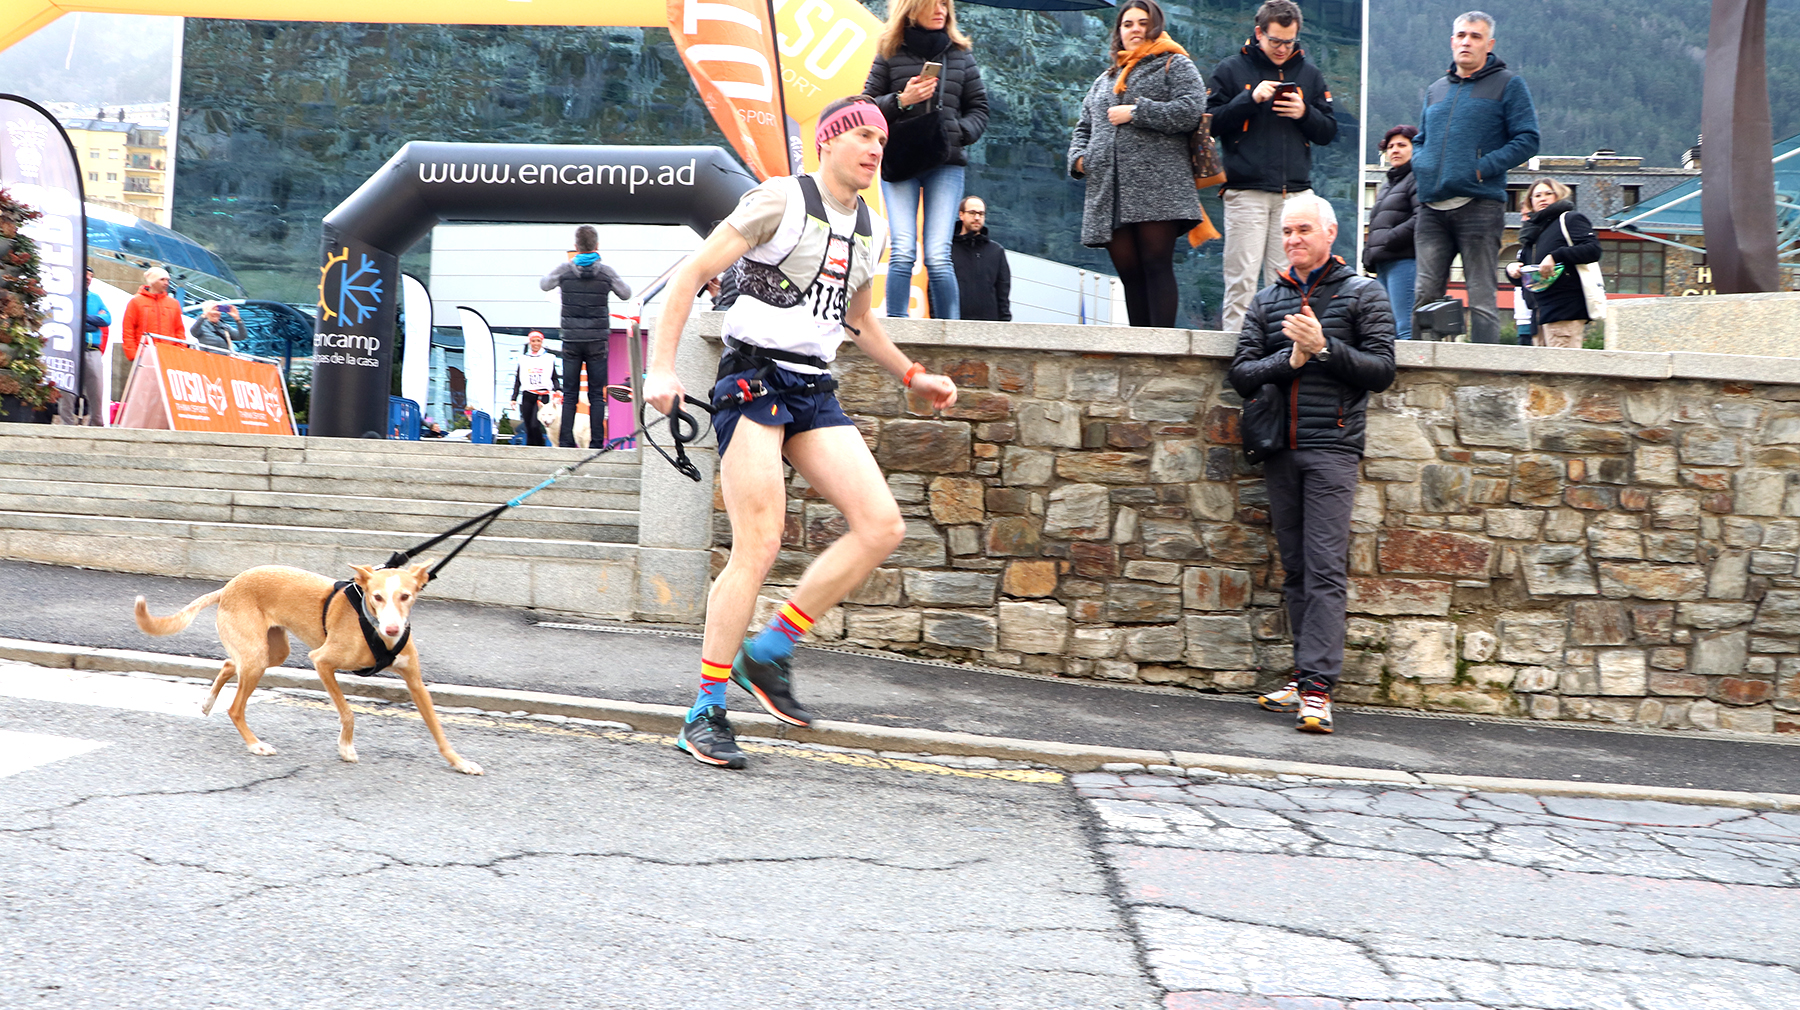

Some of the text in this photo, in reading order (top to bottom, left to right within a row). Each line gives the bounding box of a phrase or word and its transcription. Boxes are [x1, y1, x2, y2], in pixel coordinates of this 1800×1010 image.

[774, 0, 867, 80] SO
[418, 158, 697, 195] www.encamp.ad
[166, 368, 207, 403] OTSO
[230, 379, 265, 411] OTSO
